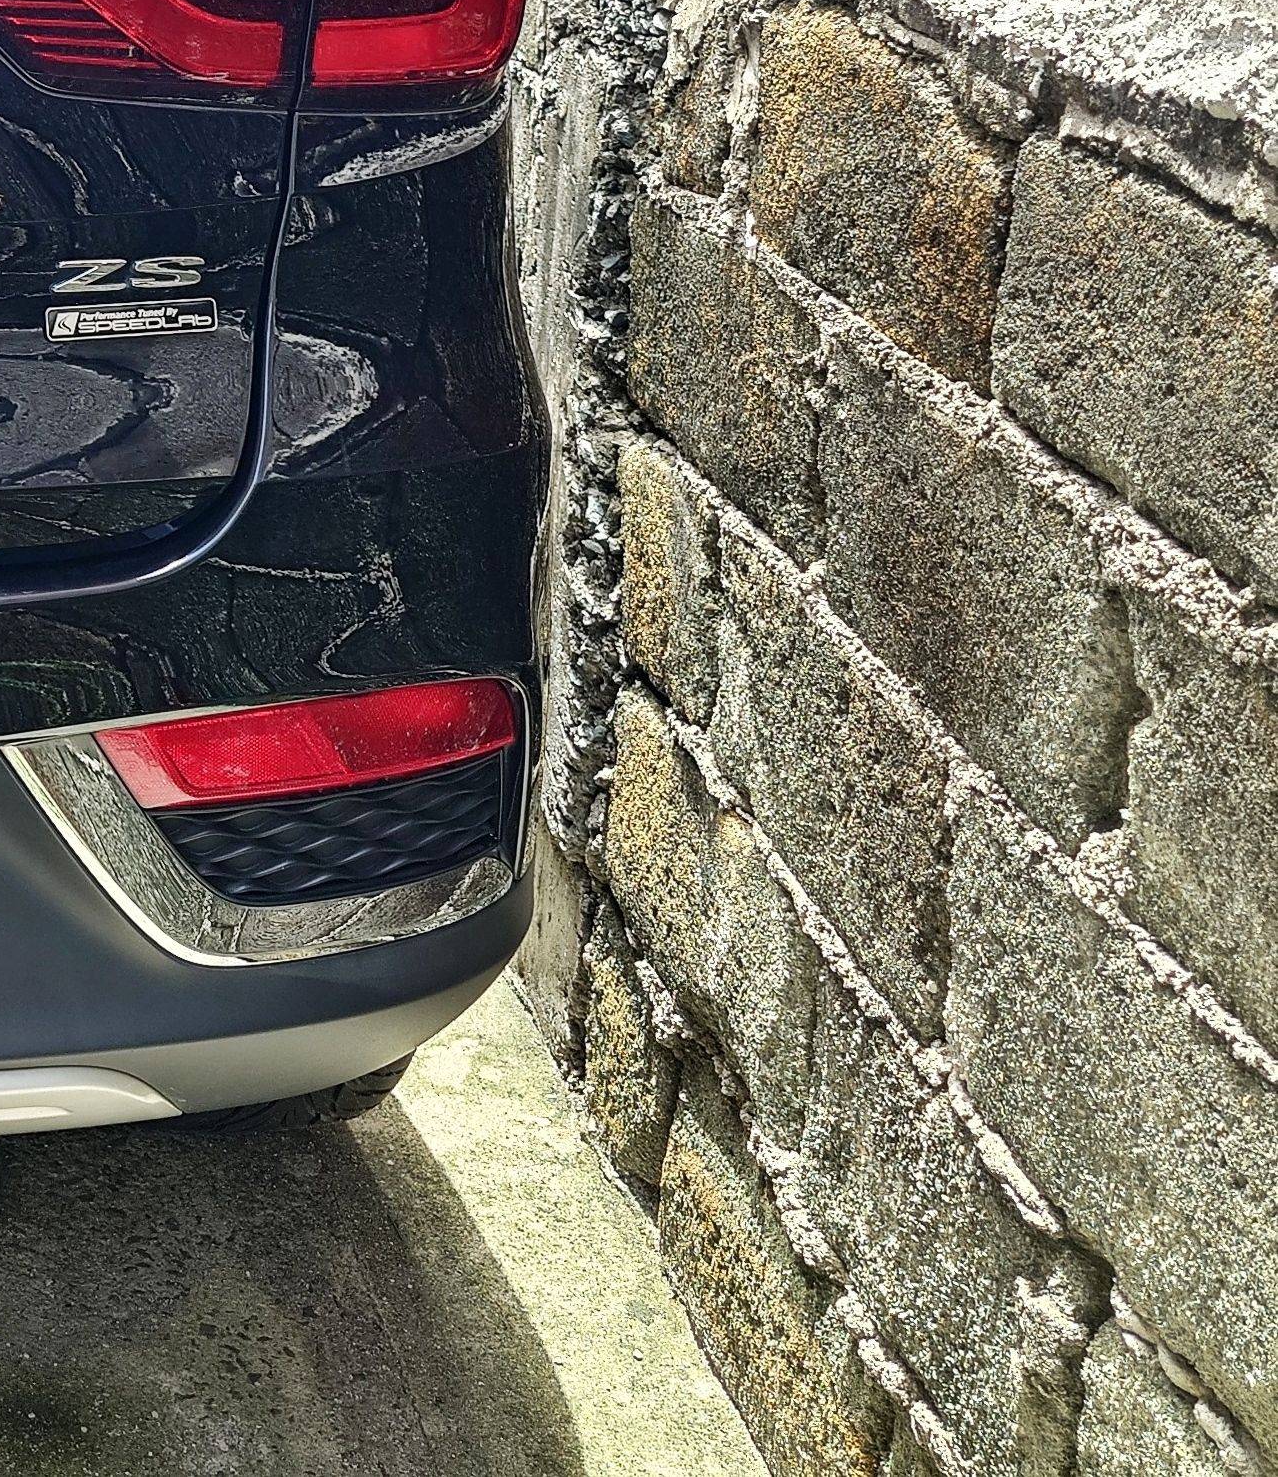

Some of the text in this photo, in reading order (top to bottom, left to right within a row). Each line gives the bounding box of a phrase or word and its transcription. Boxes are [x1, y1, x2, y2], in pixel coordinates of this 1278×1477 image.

[50, 256, 206, 293] ZS
[79, 307, 179, 322] Performance Tuned By
